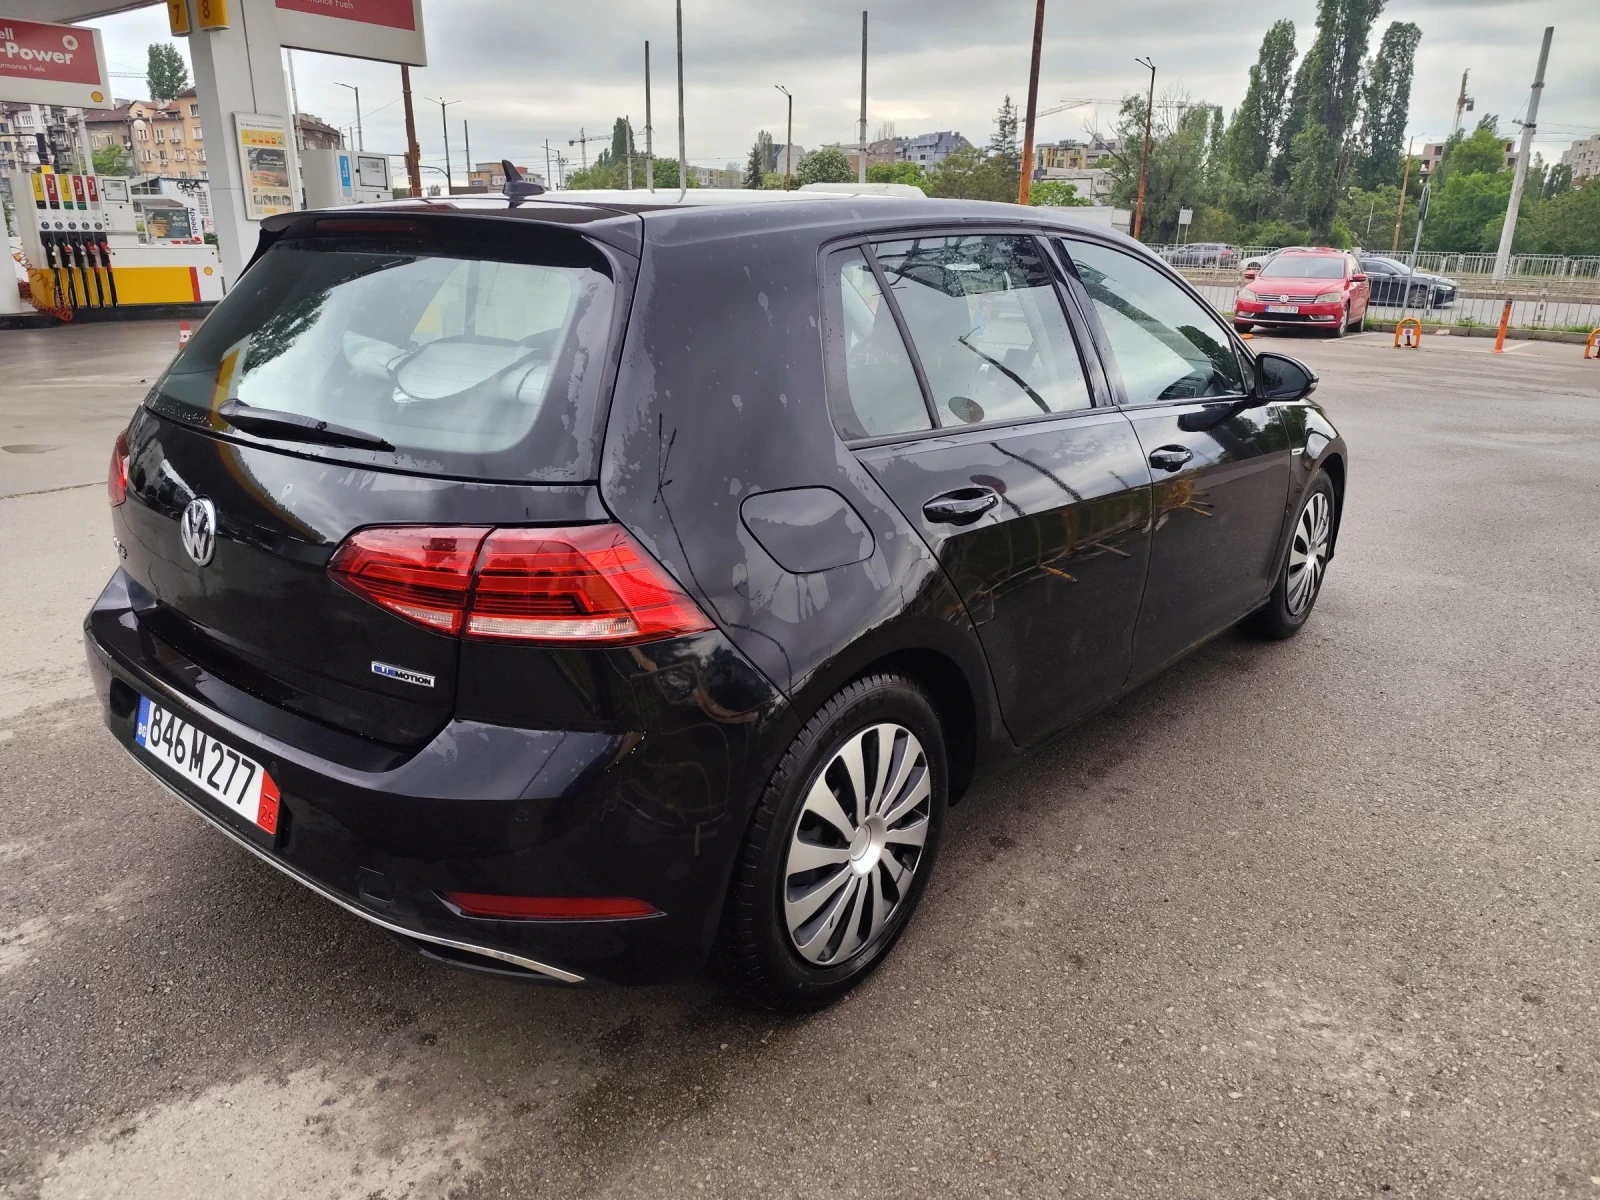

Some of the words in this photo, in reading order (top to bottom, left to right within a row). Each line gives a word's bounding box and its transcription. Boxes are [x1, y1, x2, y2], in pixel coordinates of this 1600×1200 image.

[173, 4, 180, 24] 7
[202, 0, 211, 19] 8
[28, 64, 46, 72] Fuels
[187, 207, 199, 235] speedy
[137, 721, 147, 738] BG
[262, 804, 273, 825] 26
